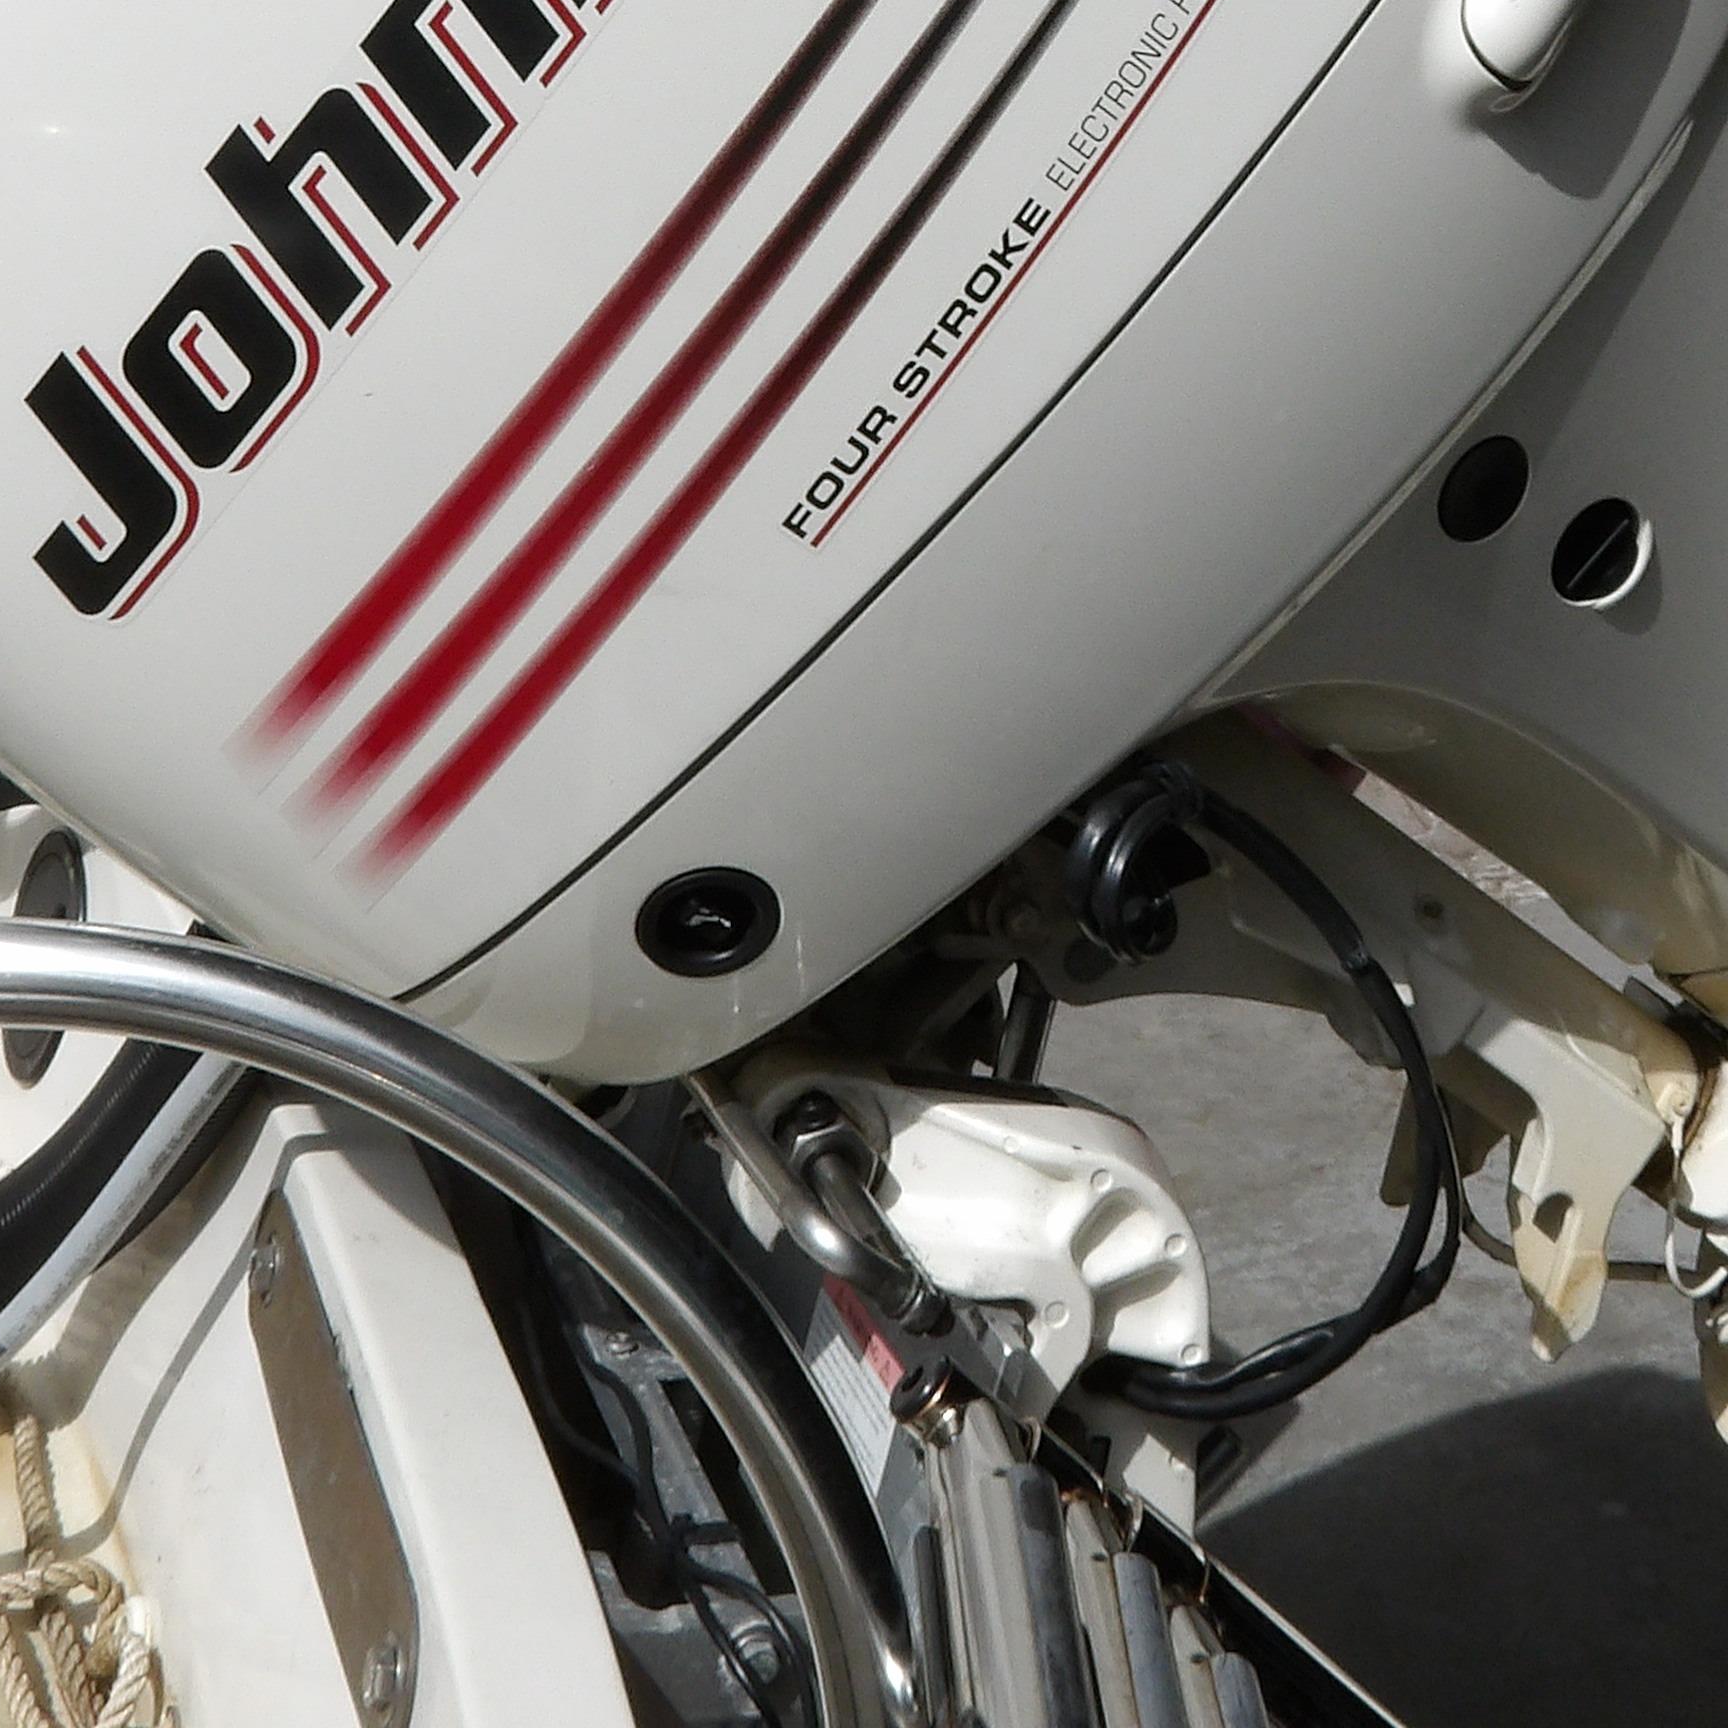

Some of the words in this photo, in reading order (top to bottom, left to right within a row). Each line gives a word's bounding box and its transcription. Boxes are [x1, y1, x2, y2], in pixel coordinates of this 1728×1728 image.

[782, 404, 898, 538] FOUR
[892, 198, 1051, 398] STROKE
[1045, 13, 1179, 192] ELECTRONIC
